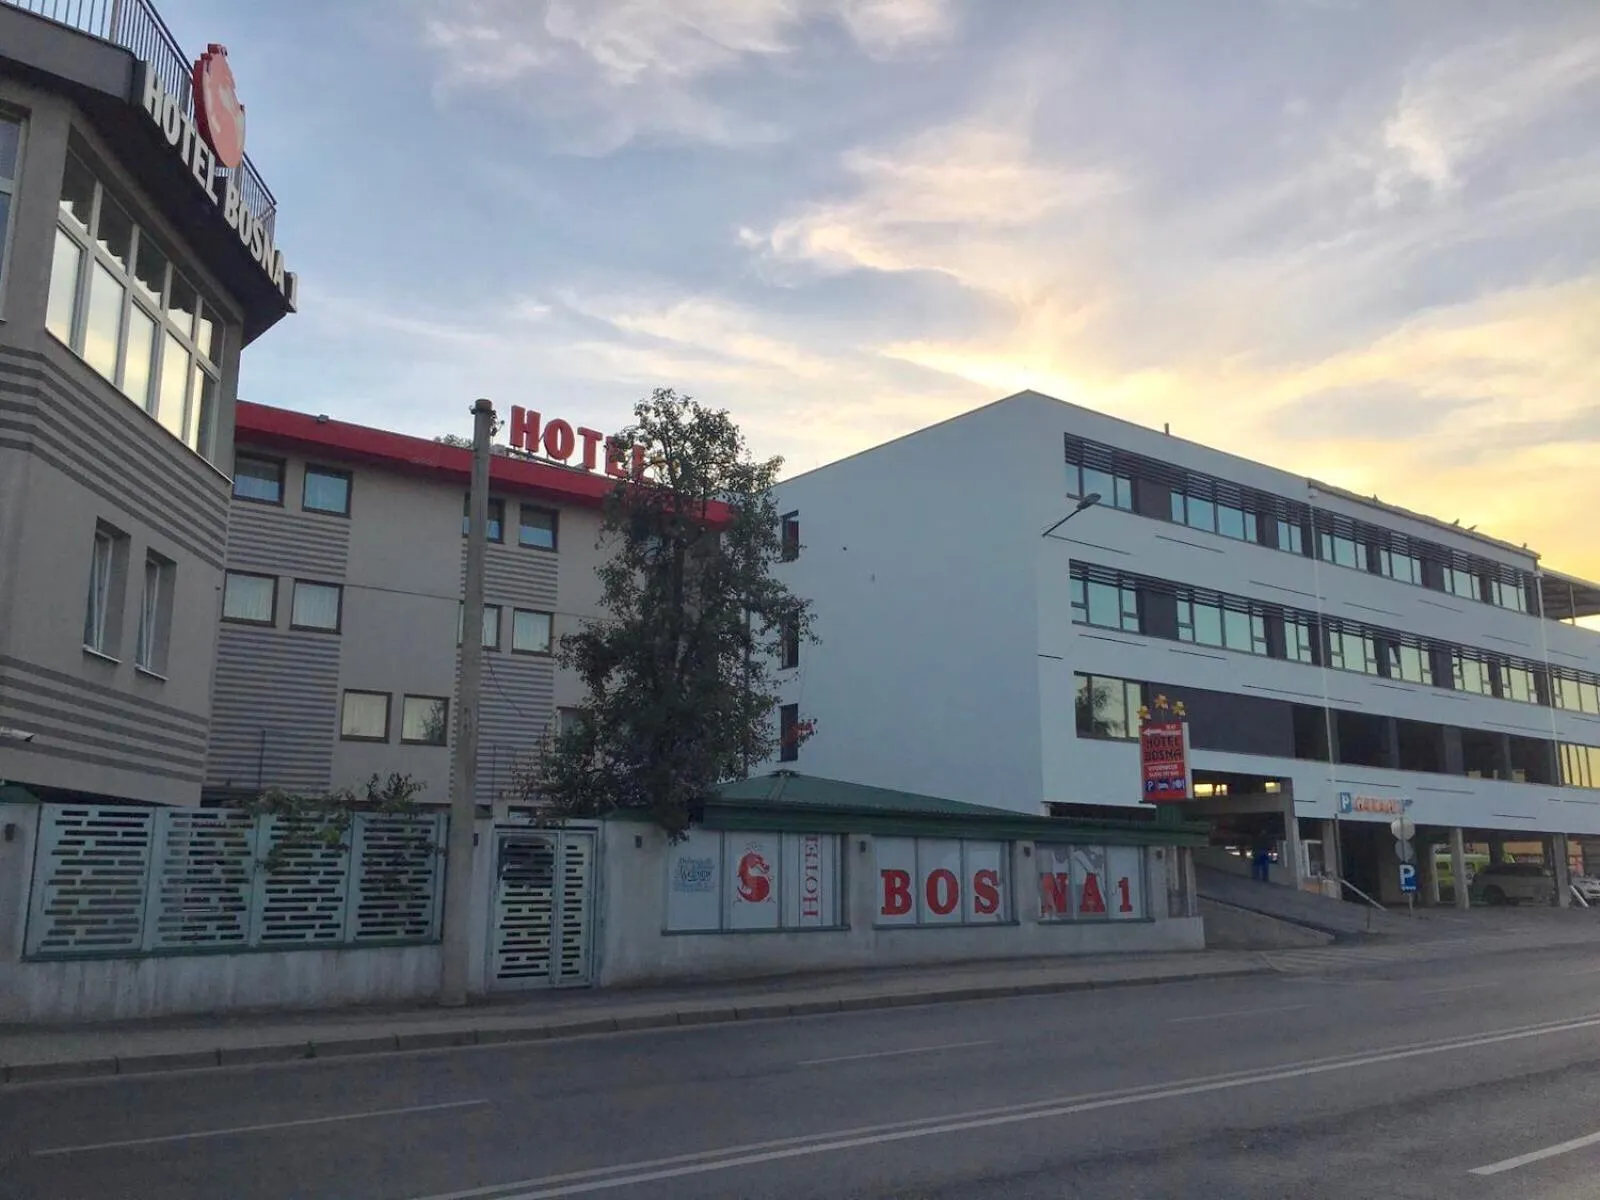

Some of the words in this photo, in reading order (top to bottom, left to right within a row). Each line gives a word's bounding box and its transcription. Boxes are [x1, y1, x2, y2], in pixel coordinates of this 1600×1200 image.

[143, 60, 218, 206] HOTEL
[224, 182, 285, 298] BOSNA
[1400, 864, 1416, 885] P
